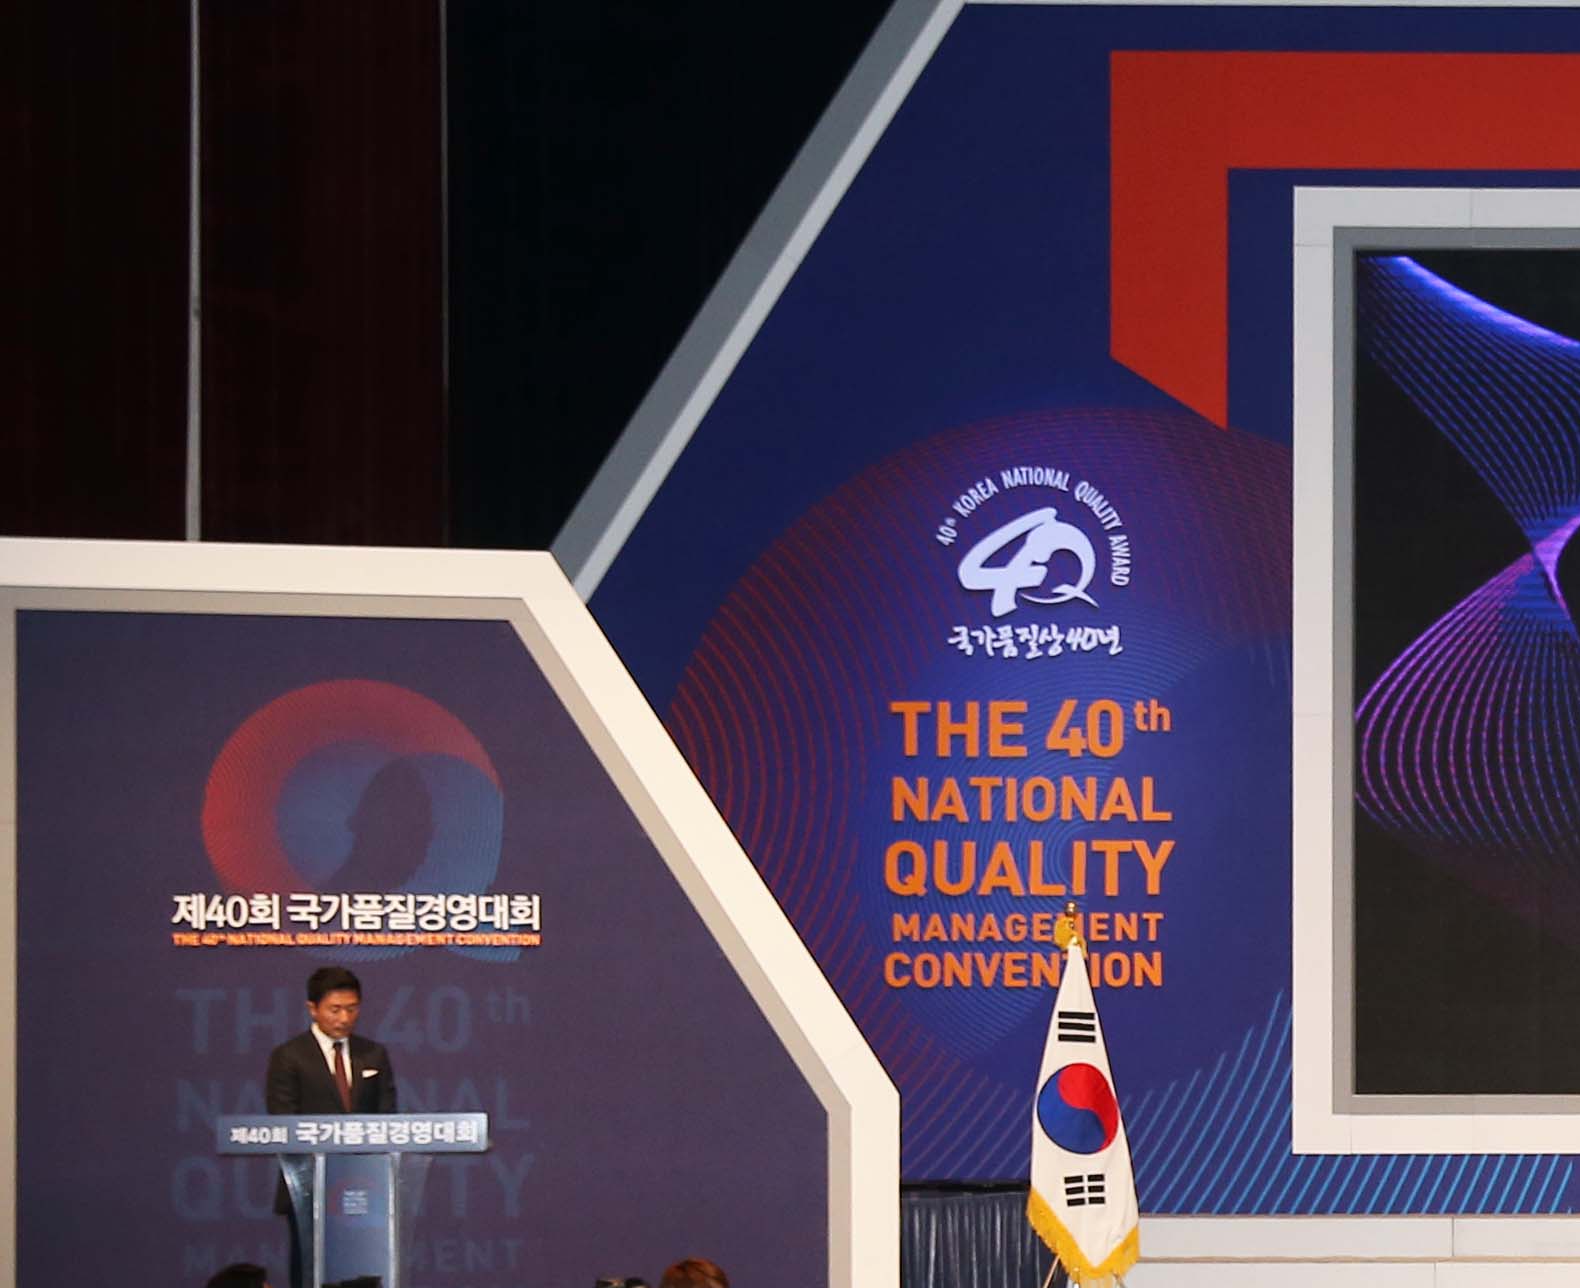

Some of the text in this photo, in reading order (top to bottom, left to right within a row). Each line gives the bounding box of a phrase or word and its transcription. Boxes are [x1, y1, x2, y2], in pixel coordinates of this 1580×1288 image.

[952, 476, 999, 518] KOREA
[1001, 466, 1070, 492] NATIONAL
[1074, 480, 1123, 531] QUALITY
[1107, 534, 1131, 587] AWARD
[889, 699, 1171, 758] THE 40th
[892, 776, 1172, 822] NATIONAL
[885, 840, 1175, 896] QUALITY
[172, 893, 539, 930] 제40회 국가품질경영대회
[893, 912, 1163, 942] MANAGEENT
[884, 951, 1162, 987] CONVENION
[230, 1121, 479, 1144] 제40회 국가품질경영대회
